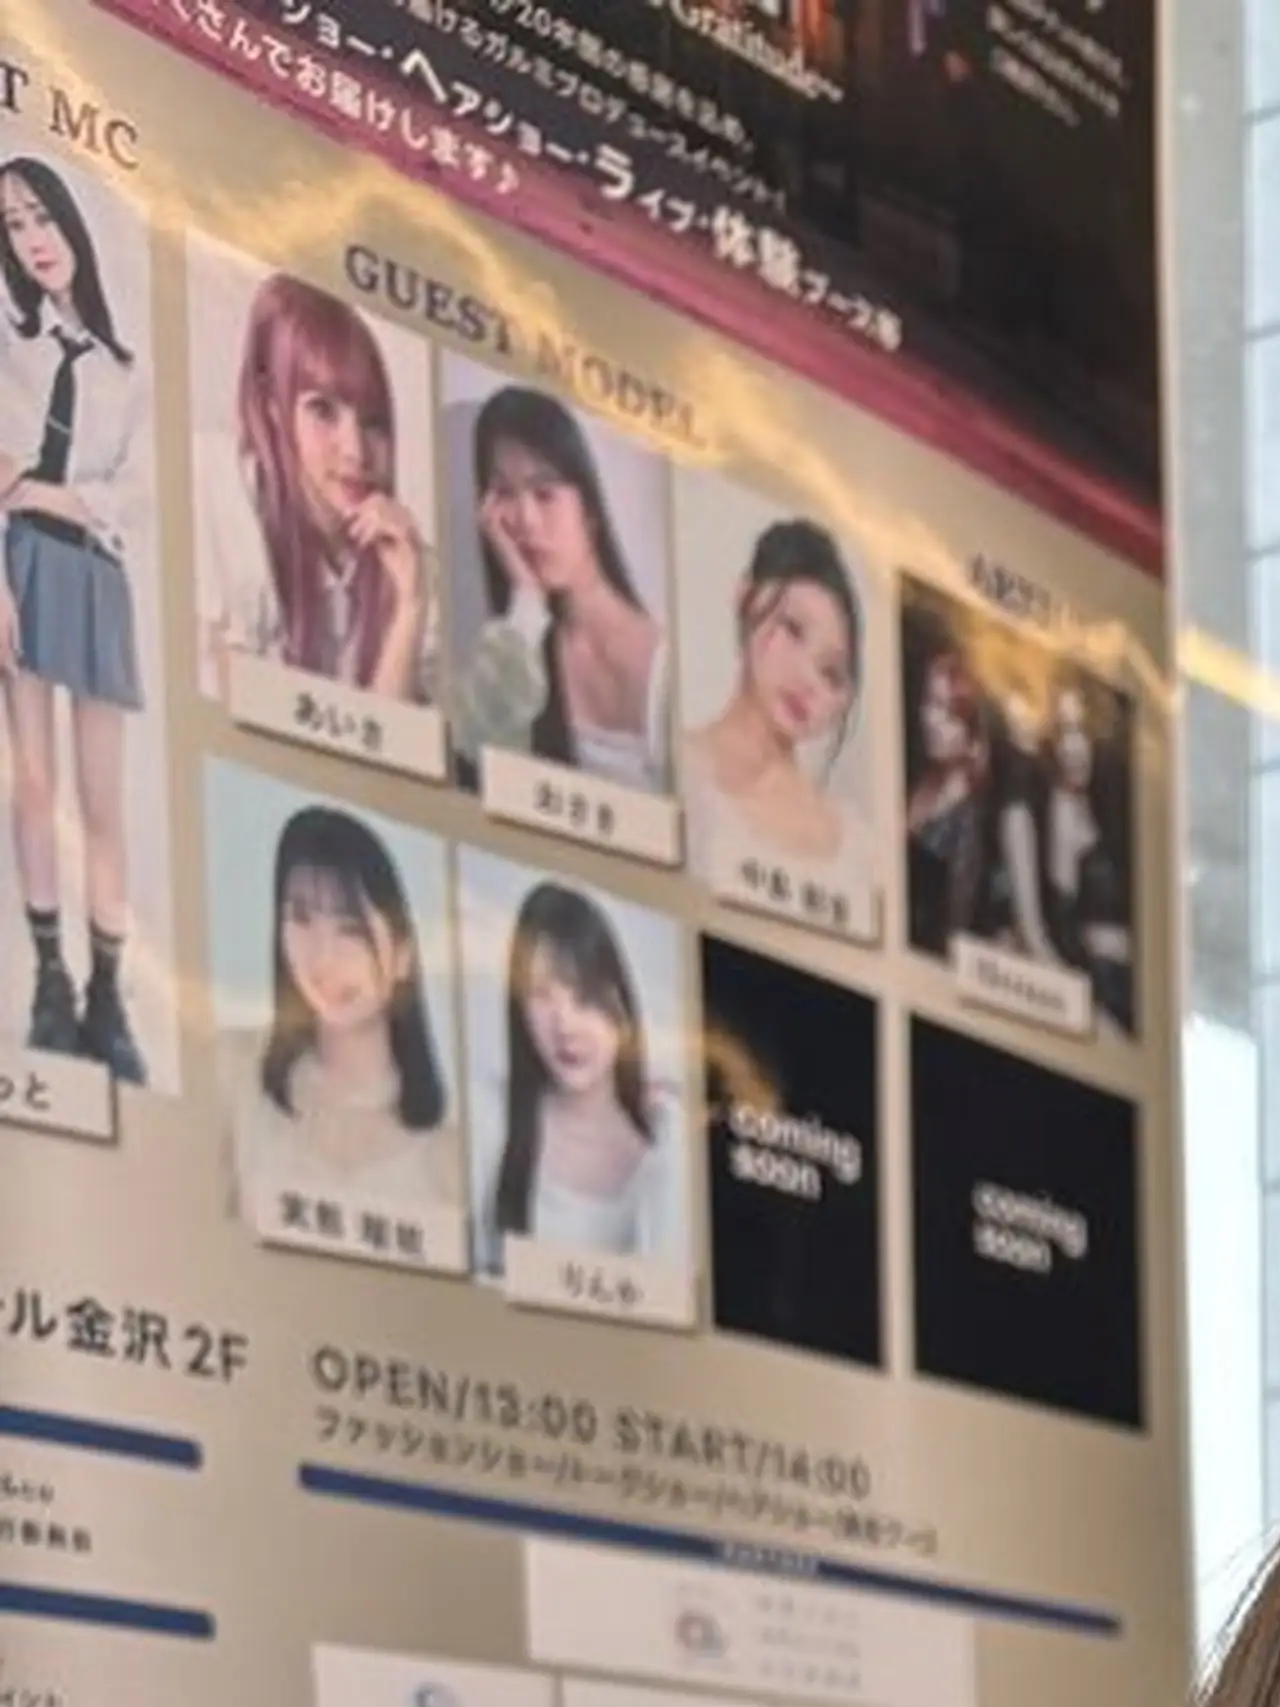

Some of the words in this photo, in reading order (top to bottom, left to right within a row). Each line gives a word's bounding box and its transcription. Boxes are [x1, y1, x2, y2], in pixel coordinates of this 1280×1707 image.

[48, 86, 139, 172] MC
[345, 245, 513, 355] GUEST
[729, 1104, 862, 1185] coming
[729, 1142, 822, 1202] soon
[972, 1180, 1088, 1260] coming
[972, 1218, 1053, 1274] soon
[0, 1287, 171, 1370] ル金沢
